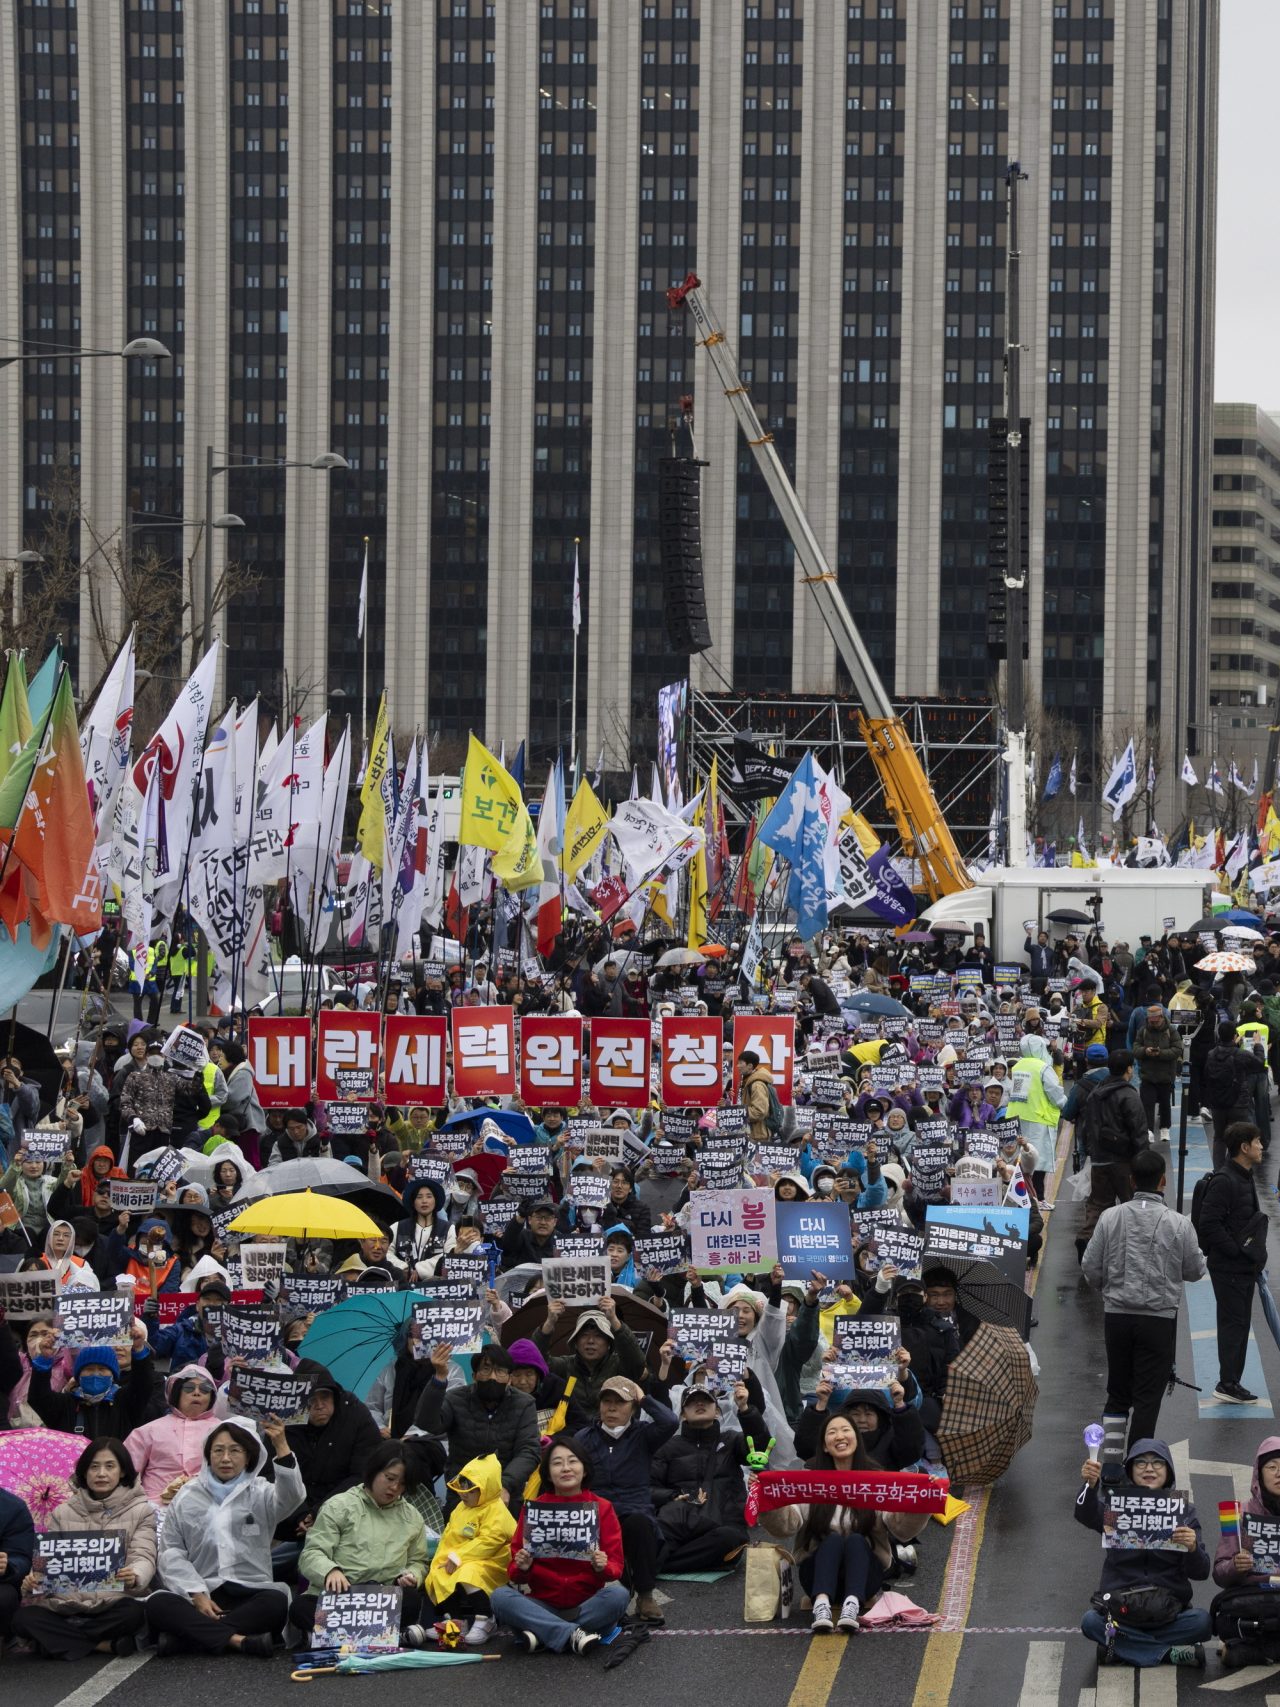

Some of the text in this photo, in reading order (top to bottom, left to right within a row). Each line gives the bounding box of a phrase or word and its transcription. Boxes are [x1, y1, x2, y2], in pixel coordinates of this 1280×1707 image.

[882, 728, 895, 750] KATO
[586, 1134, 620, 1147] 내란세력
[586, 1146, 620, 1158] 청산하자
[112, 1192, 155, 1208] 해체하라
[701, 1201, 767, 1230] 다시 봄
[800, 1218, 824, 1232] 다시
[706, 1234, 761, 1249] 대한민국
[789, 1235, 839, 1249] 대한민국
[874, 1228, 924, 1251] 민주주의가
[929, 1227, 1022, 1251] 구미옵티칼 공장 옥상
[929, 1238, 967, 1252] 고공농성
[782, 1255, 796, 1263] 이재
[877, 1242, 922, 1263] 승리했다
[547, 1264, 605, 1282] 내란세력
[283, 1277, 343, 1292] 민주주의가
[413, 1284, 473, 1299] 민주주의가
[549, 1281, 606, 1299] 청산하자
[58, 1298, 130, 1315] 민주주의가
[415, 1306, 482, 1323] 민주주의가
[63, 1314, 122, 1330] 승리했다
[222, 1311, 281, 1336] 민주주의가
[672, 1312, 735, 1328] 민주주의가
[837, 1321, 898, 1335] 민주주의가
[420, 1321, 473, 1339] 승리했다
[226, 1330, 272, 1351] 승리했다
[841, 1334, 893, 1350] 승리했다
[236, 1375, 312, 1396] 민주주의가
[241, 1391, 301, 1410] 승리했다
[763, 1477, 947, 1503] 대한민국은 민주공화국이다
[1110, 1494, 1185, 1514] 민주주의가
[526, 1508, 597, 1525] 민주주의가
[1116, 1513, 1178, 1531] 승리했다
[530, 1525, 591, 1543] 승리했다
[39, 1537, 121, 1557] 민주주의가
[46, 1556, 112, 1574] 승리했다
[322, 1592, 398, 1611] 민주주의가
[326, 1610, 389, 1628] 승리했다
